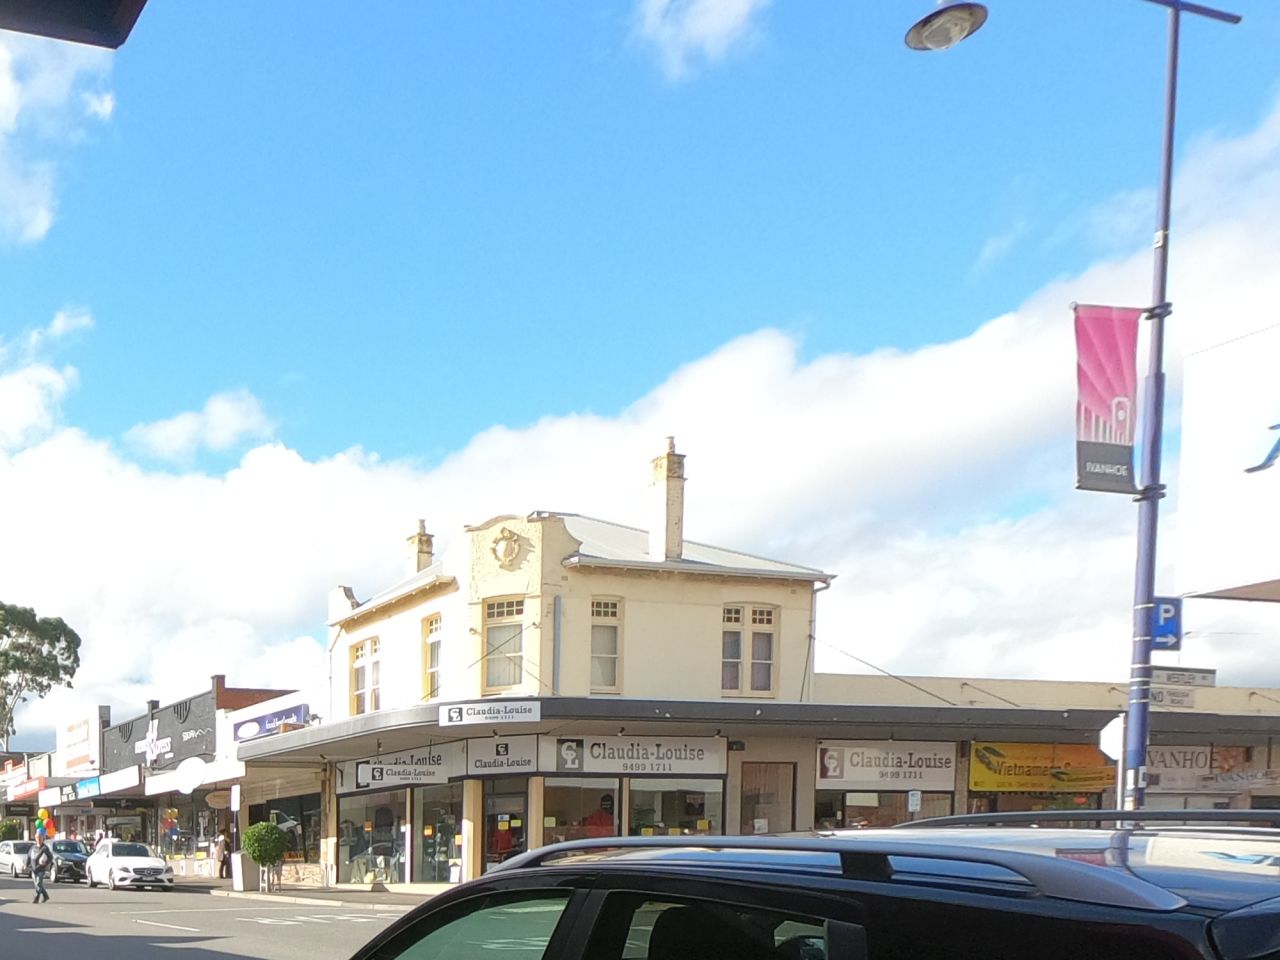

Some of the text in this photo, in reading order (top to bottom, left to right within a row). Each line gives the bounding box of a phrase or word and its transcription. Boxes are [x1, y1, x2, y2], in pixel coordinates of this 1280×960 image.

[1085, 460, 1129, 477] IVANHOE
[1158, 603, 1176, 626] P
[465, 704, 533, 717] Claudia-Louise
[589, 742, 705, 762] Claudia-Louise
[849, 752, 952, 769] Claudia-Louise
[1147, 750, 1221, 770] VANHOE
[474, 758, 532, 769] Claudia-Louise
[622, 763, 673, 772] 9499 1711
[385, 768, 436, 777] Claudia-Louise
